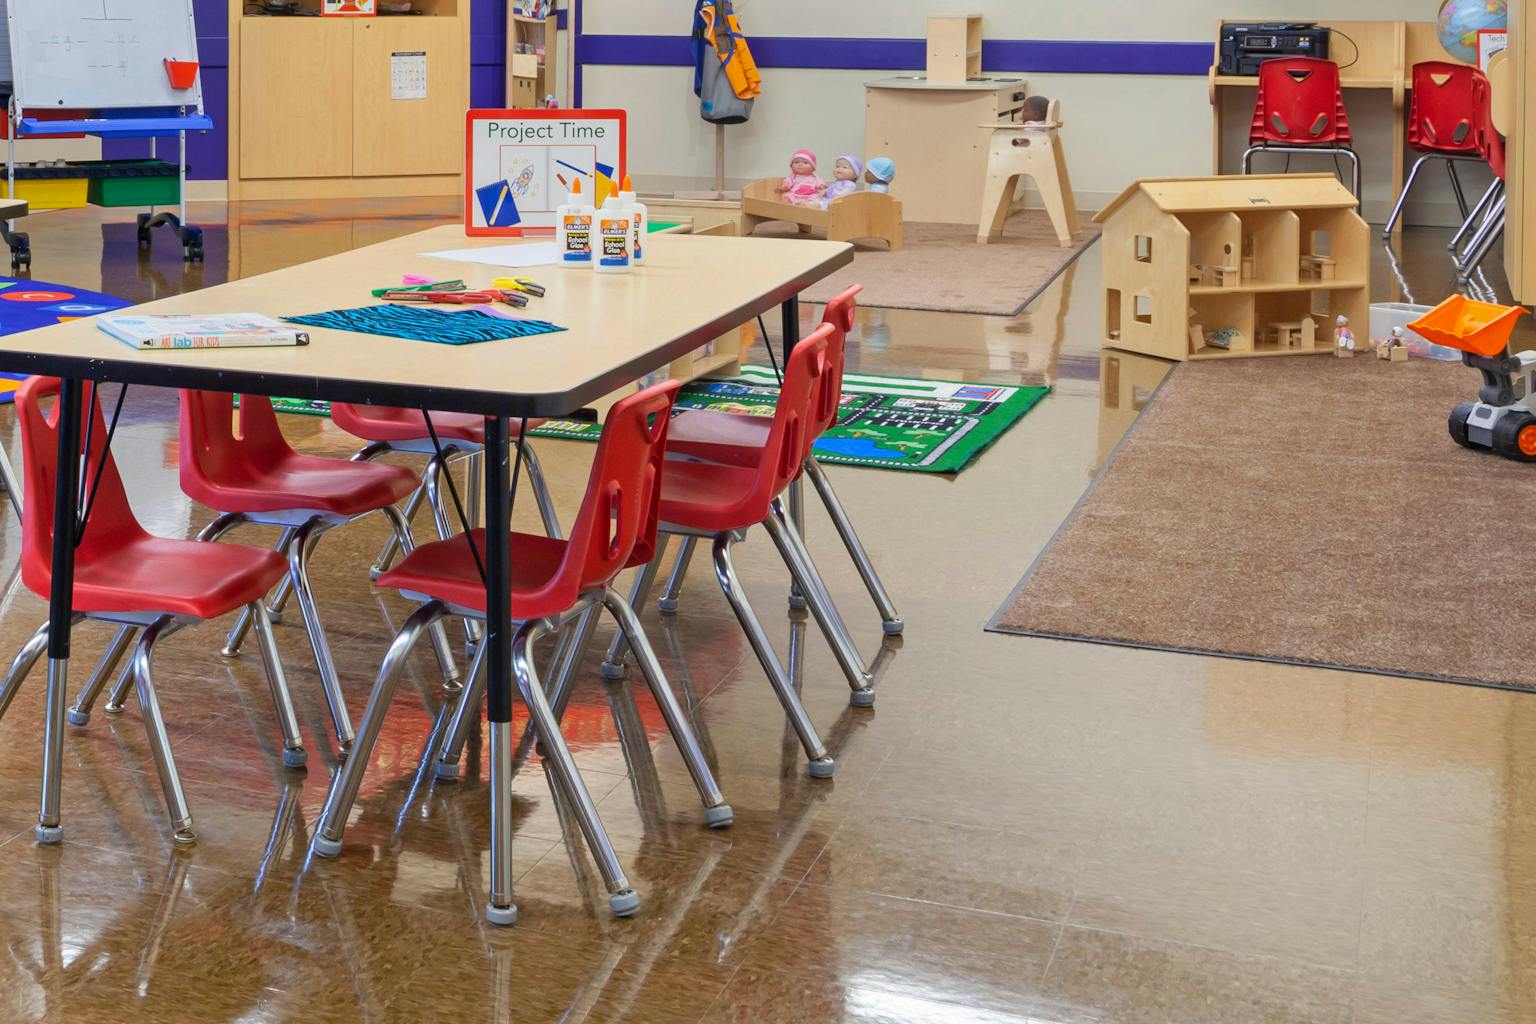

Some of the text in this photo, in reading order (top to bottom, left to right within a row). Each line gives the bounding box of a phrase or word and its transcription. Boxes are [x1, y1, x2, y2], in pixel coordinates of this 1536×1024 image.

[488, 122, 605, 143] Project Time
[173, 336, 192, 347] lab
